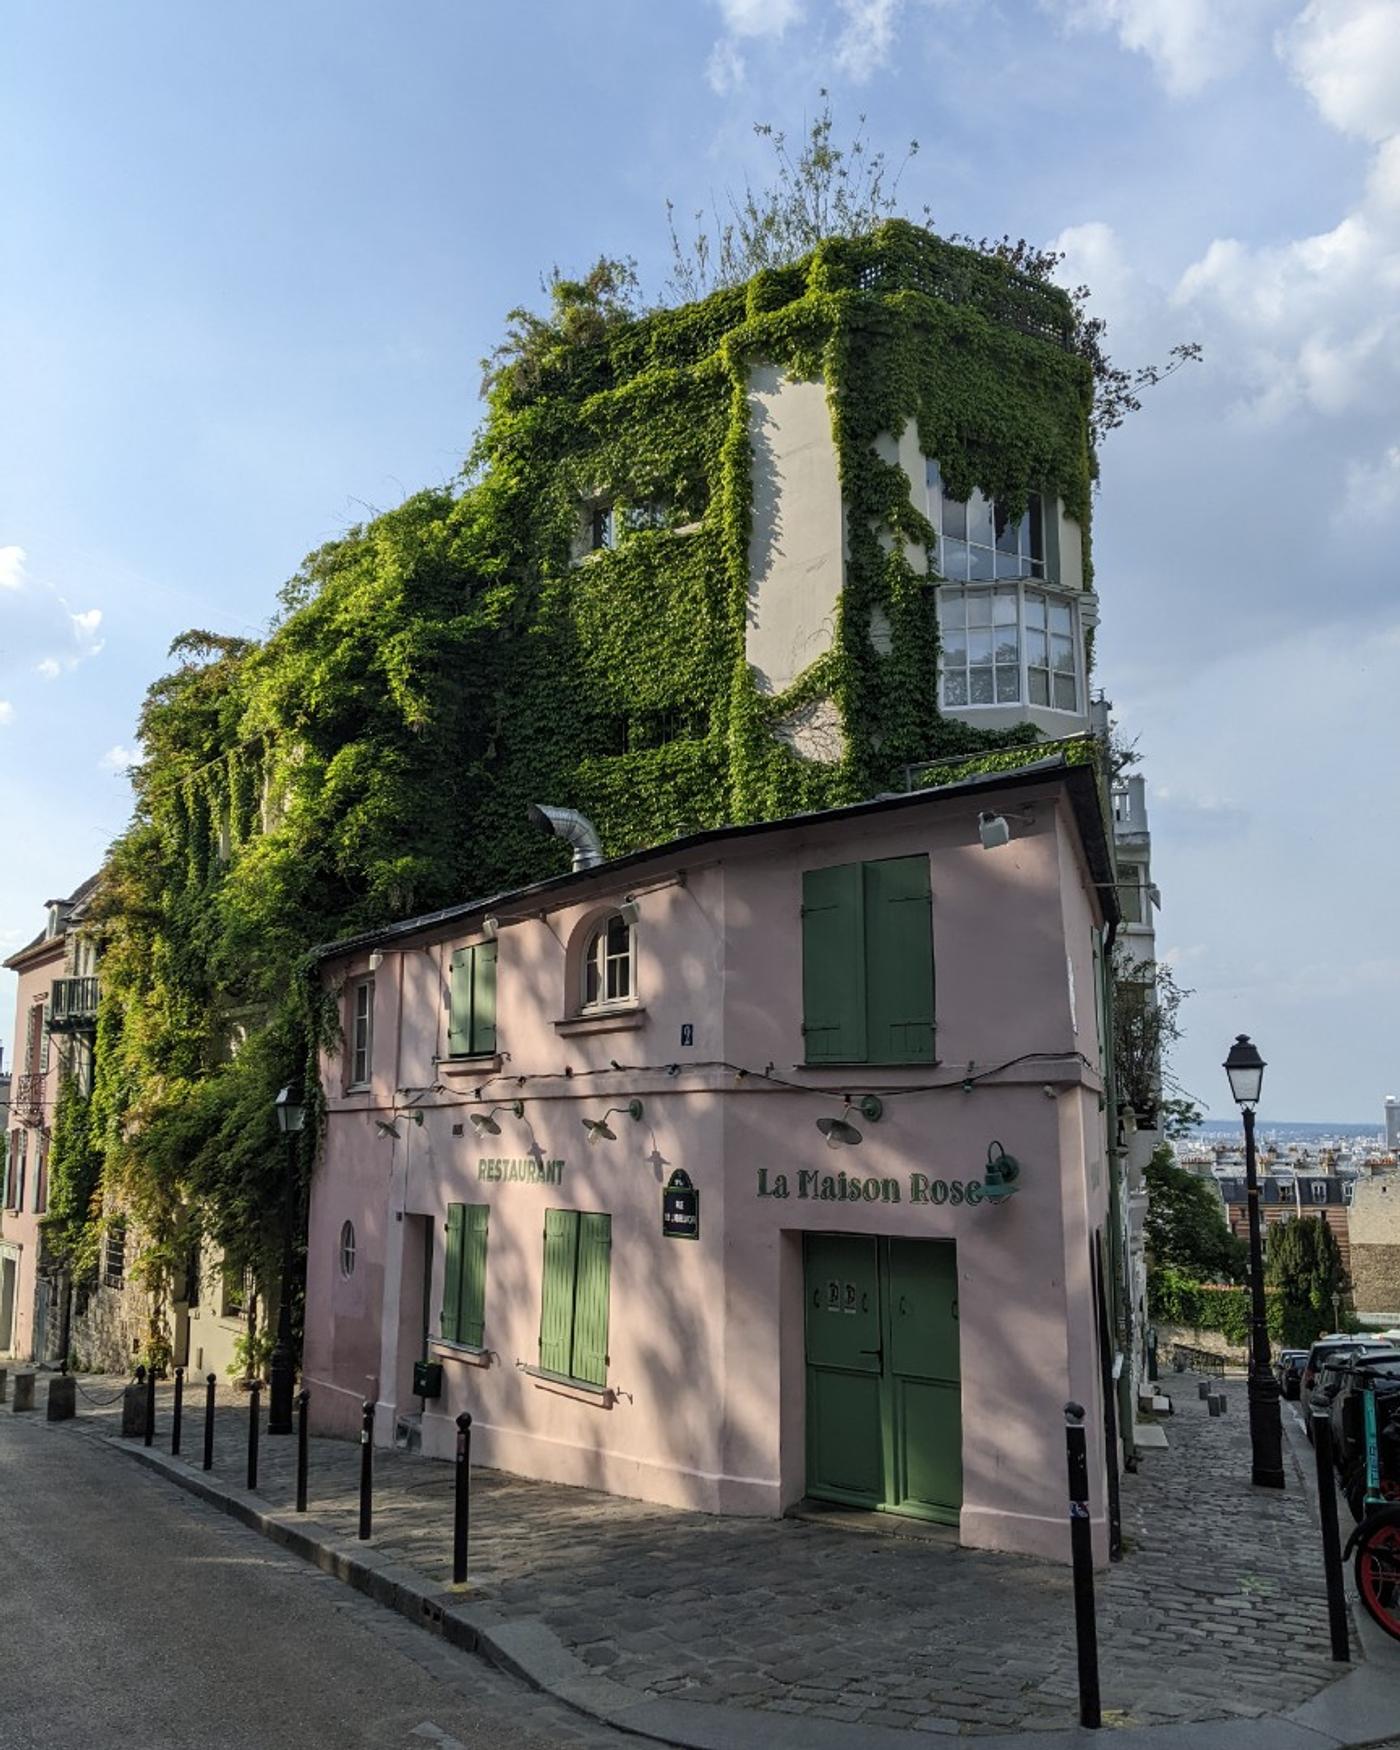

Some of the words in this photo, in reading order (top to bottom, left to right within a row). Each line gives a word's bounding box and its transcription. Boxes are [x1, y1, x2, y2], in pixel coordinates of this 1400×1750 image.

[478, 1159, 565, 1185] RESTAURANT
[757, 1168, 790, 1199] La
[797, 1170, 901, 1203] Maison
[909, 1173, 984, 1206] Rose
